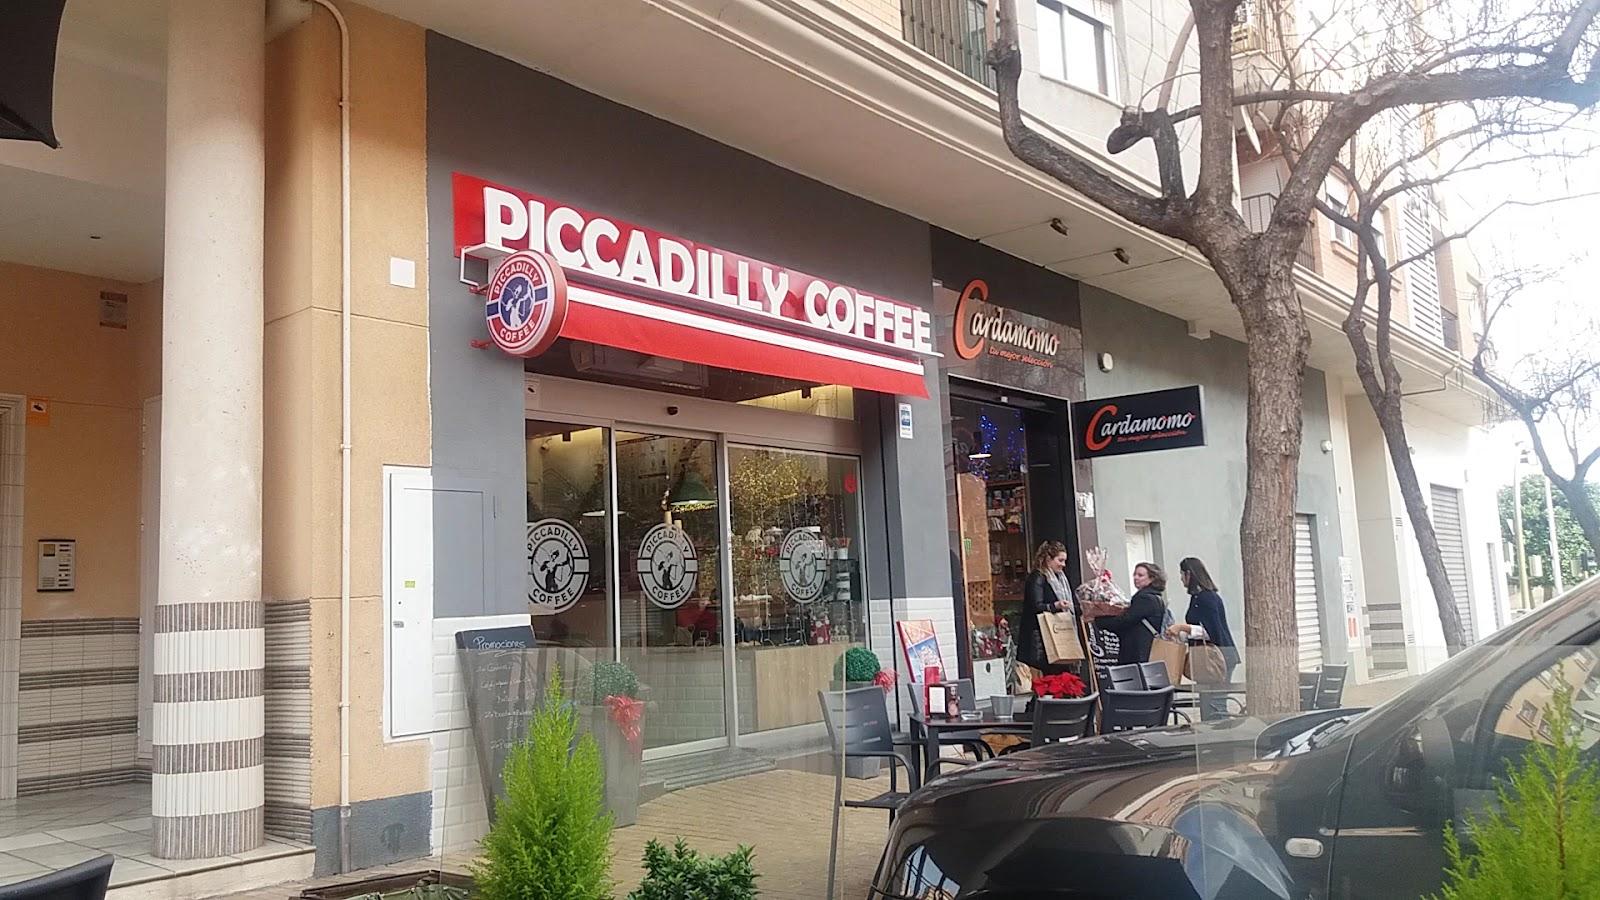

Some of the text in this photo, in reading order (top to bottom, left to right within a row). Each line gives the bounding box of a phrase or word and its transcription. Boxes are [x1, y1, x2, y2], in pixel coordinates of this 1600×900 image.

[483, 186, 931, 351] PICCADILLY COFFEE
[494, 262, 539, 294] PICCADILLY
[500, 319, 535, 342] COFFEE
[954, 279, 1060, 360] Cardamomo
[1086, 404, 1195, 450] Cardamomo
[527, 527, 579, 551] PICCADILLY
[646, 530, 689, 553] PICCADIY
[533, 587, 574, 605] COFFEE
[652, 584, 686, 601] COFFEE
[791, 582, 818, 597] COFFEE
[472, 635, 527, 650] Promociones
